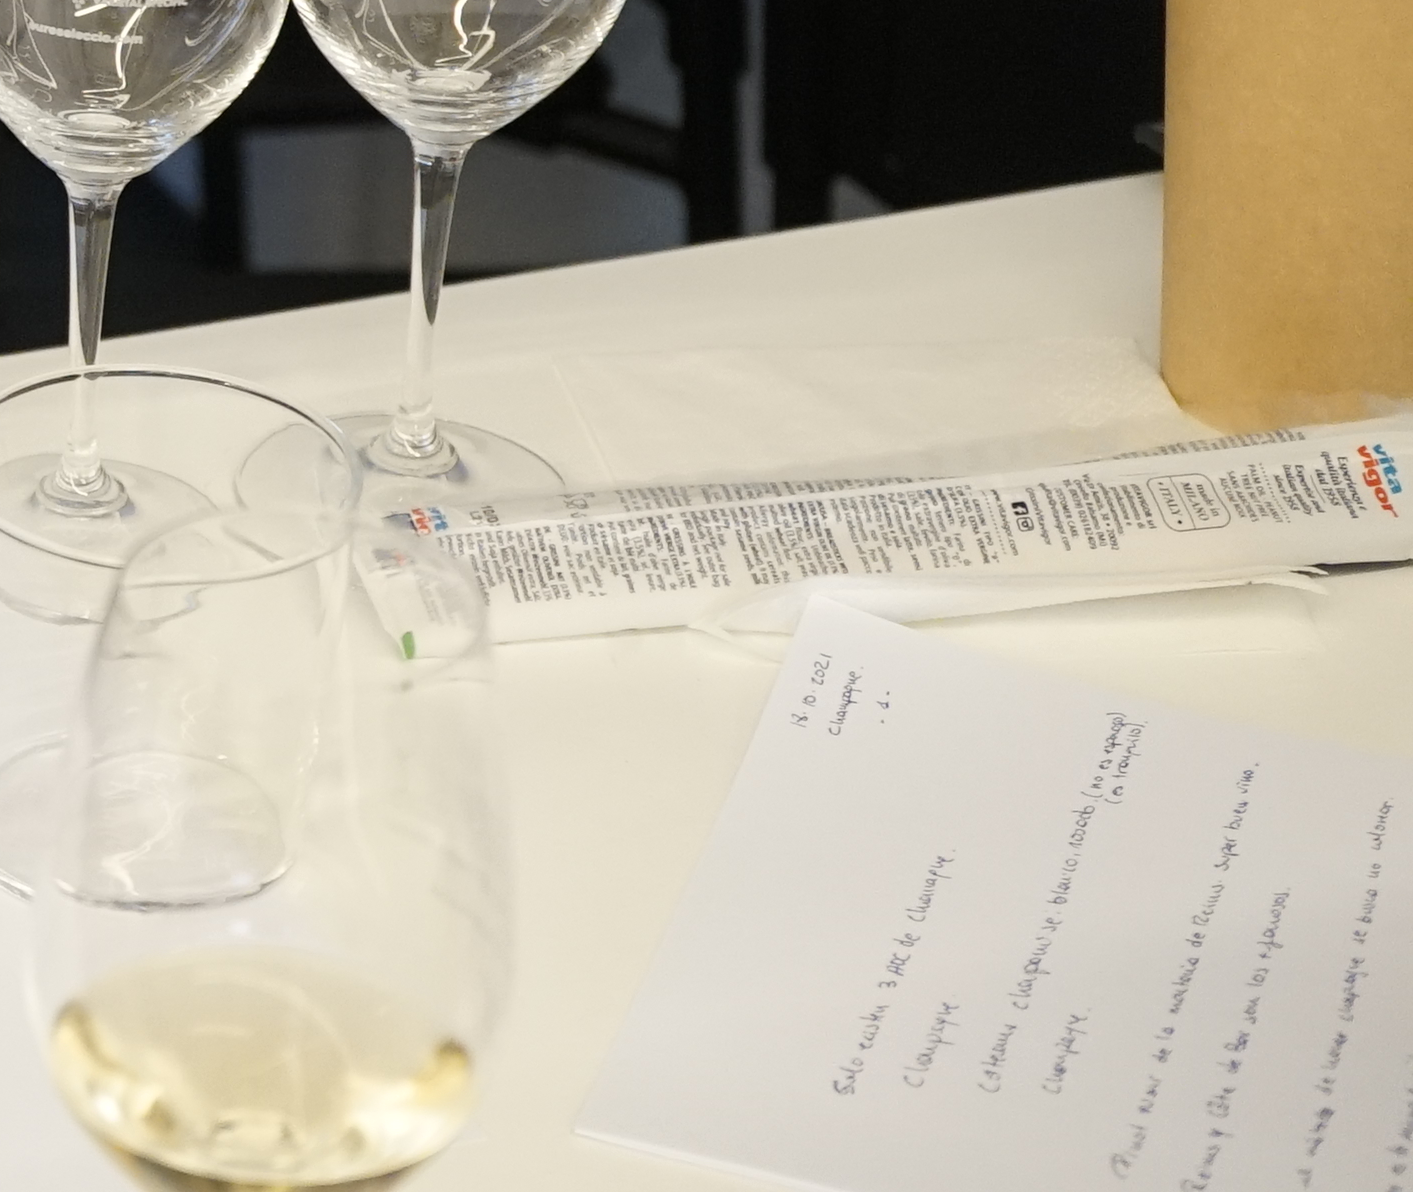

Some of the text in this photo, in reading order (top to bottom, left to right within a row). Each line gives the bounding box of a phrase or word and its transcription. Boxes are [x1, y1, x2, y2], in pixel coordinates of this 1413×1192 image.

[1226, 470, 1239, 489] SANS
[1241, 473, 1255, 491] TREE
[1248, 464, 1263, 484] PALM
[1314, 469, 1329, 485] dal
[1357, 445, 1399, 518] vigor
[1372, 444, 1403, 495] vita
[1159, 488, 1182, 517] ITALY
[1181, 482, 1210, 521] MILANO
[1196, 484, 1220, 517] made in
[811, 653, 832, 686] 2021
[1236, 763, 1259, 795] vino.
[1223, 801, 1250, 831] buen
[893, 933, 921, 948] de
[1185, 932, 1207, 948] de
[1352, 929, 1368, 945] se
[1245, 967, 1271, 988] los
